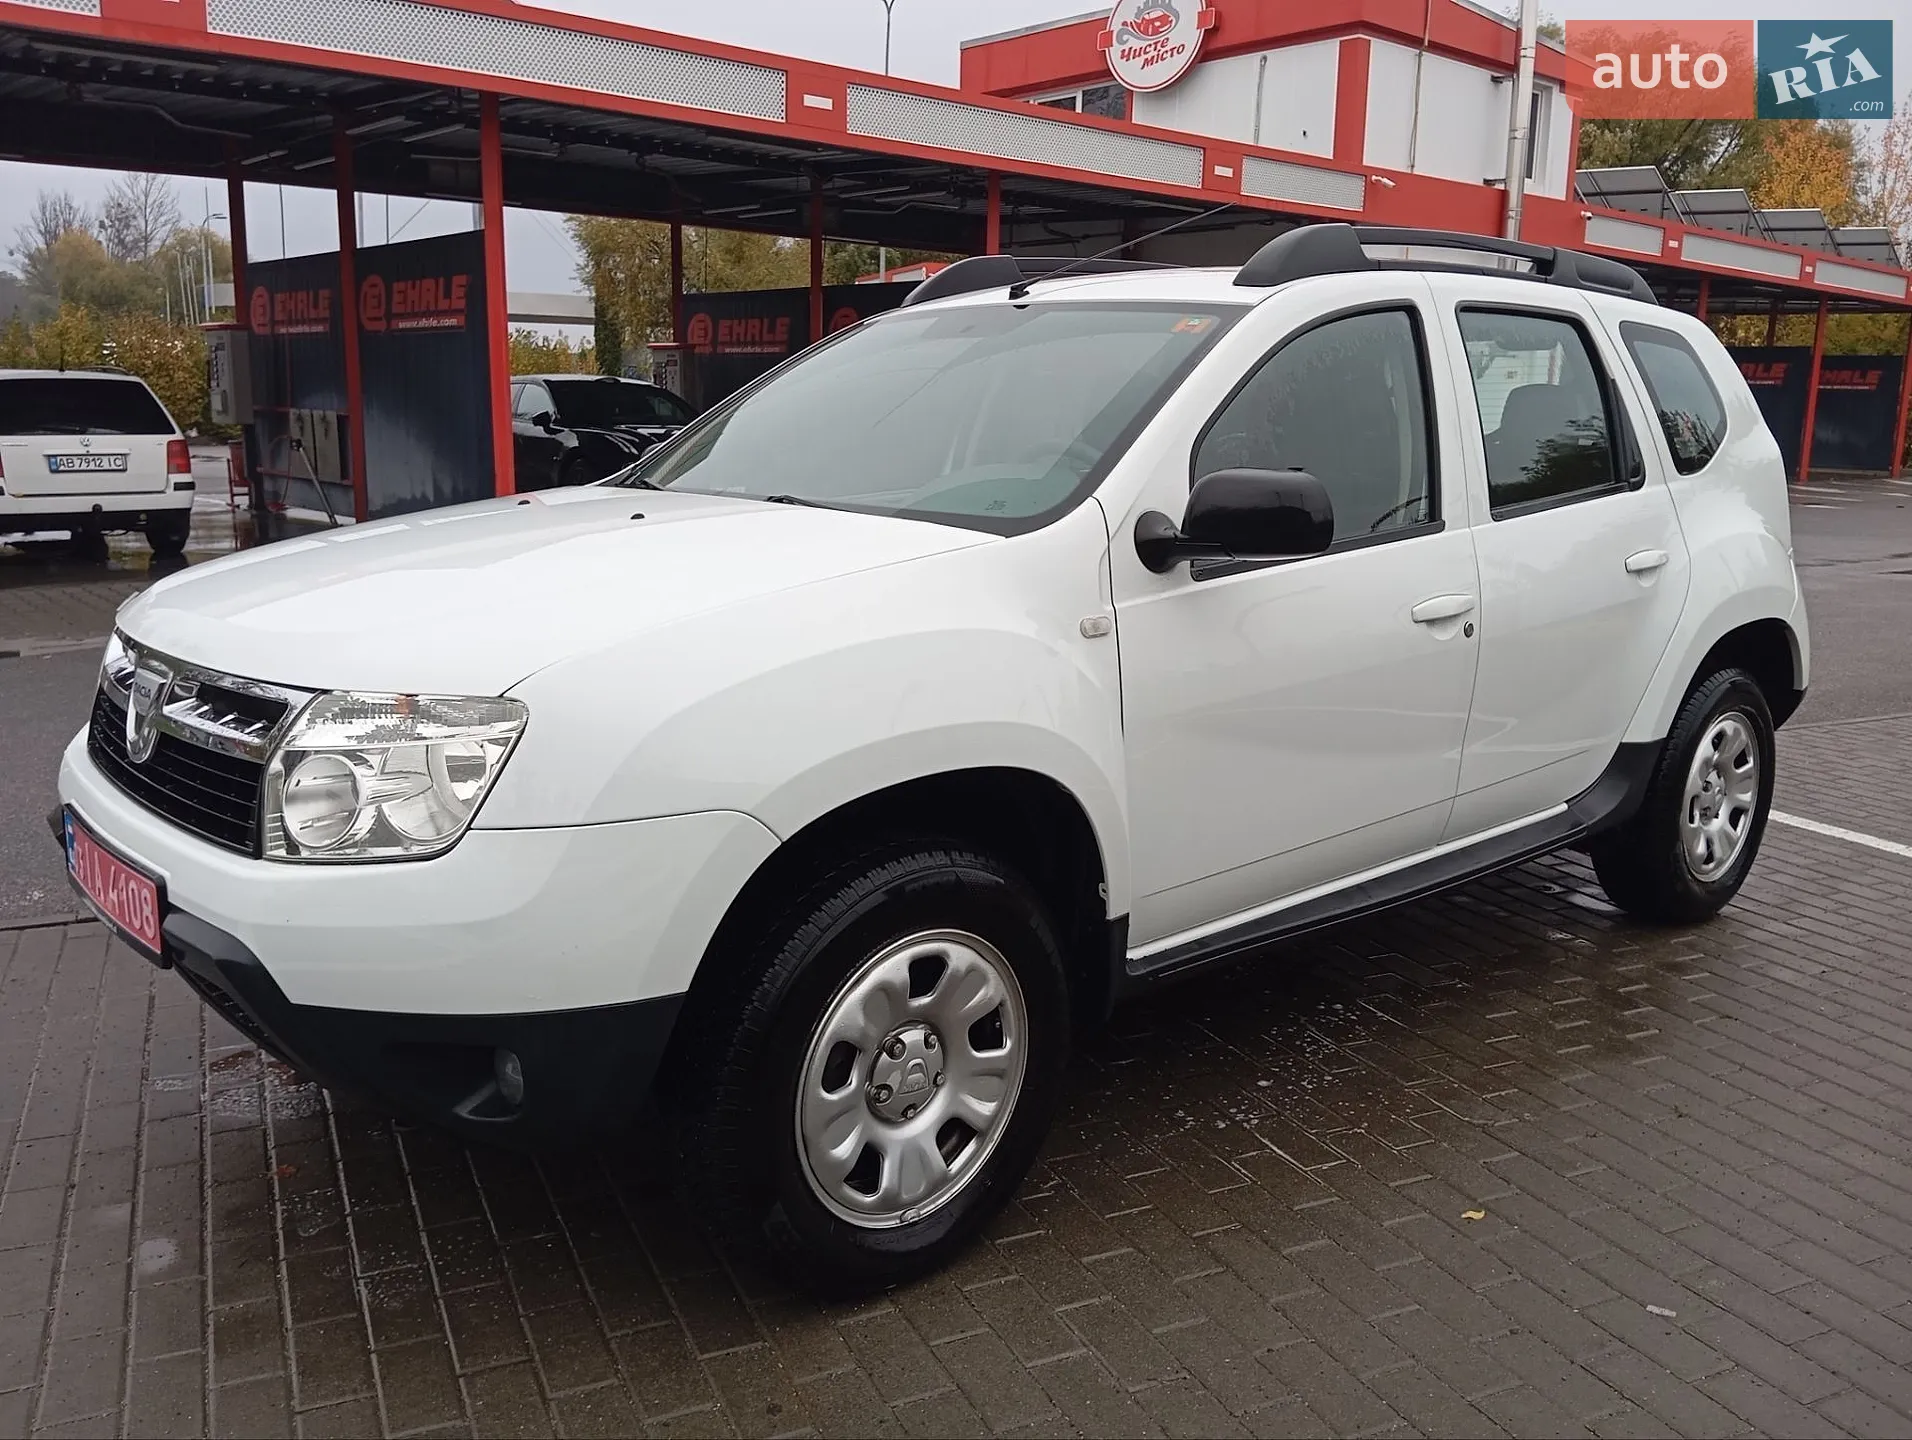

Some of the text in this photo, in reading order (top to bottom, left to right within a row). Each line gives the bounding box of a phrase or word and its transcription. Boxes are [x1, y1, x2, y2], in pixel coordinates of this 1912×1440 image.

[1120, 37, 1170, 62] Чисте
[1140, 44, 1186, 70] місто
[718, 317, 791, 342] EHRLE
[1820, 370, 1882, 385] HRLE
[58, 457, 122, 469] AB 7912 IC
[107, 864, 156, 940] 4108
